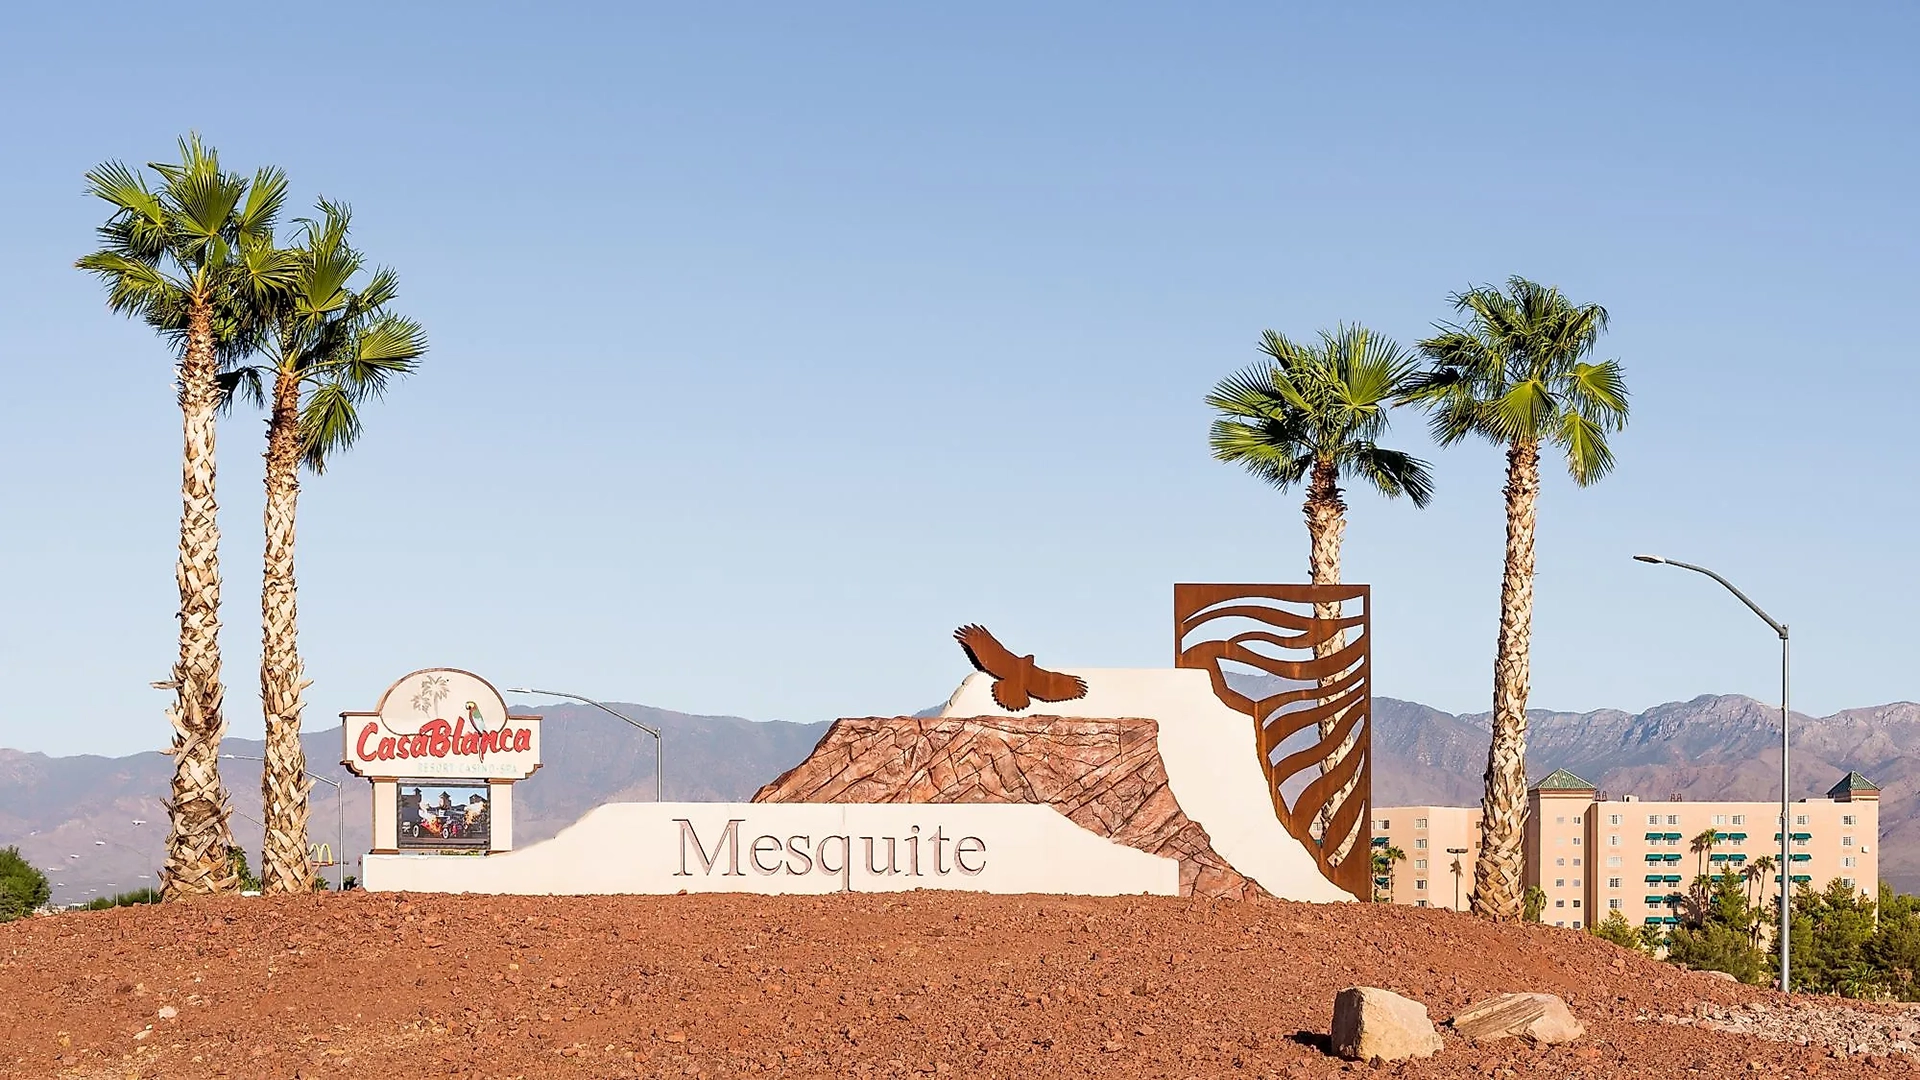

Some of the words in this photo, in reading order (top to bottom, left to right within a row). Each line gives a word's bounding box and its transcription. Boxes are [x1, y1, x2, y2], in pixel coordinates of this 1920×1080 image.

[357, 717, 531, 762] CasaBlanca
[418, 763, 454, 773] RESORT
[672, 818, 986, 892] Mesquite
